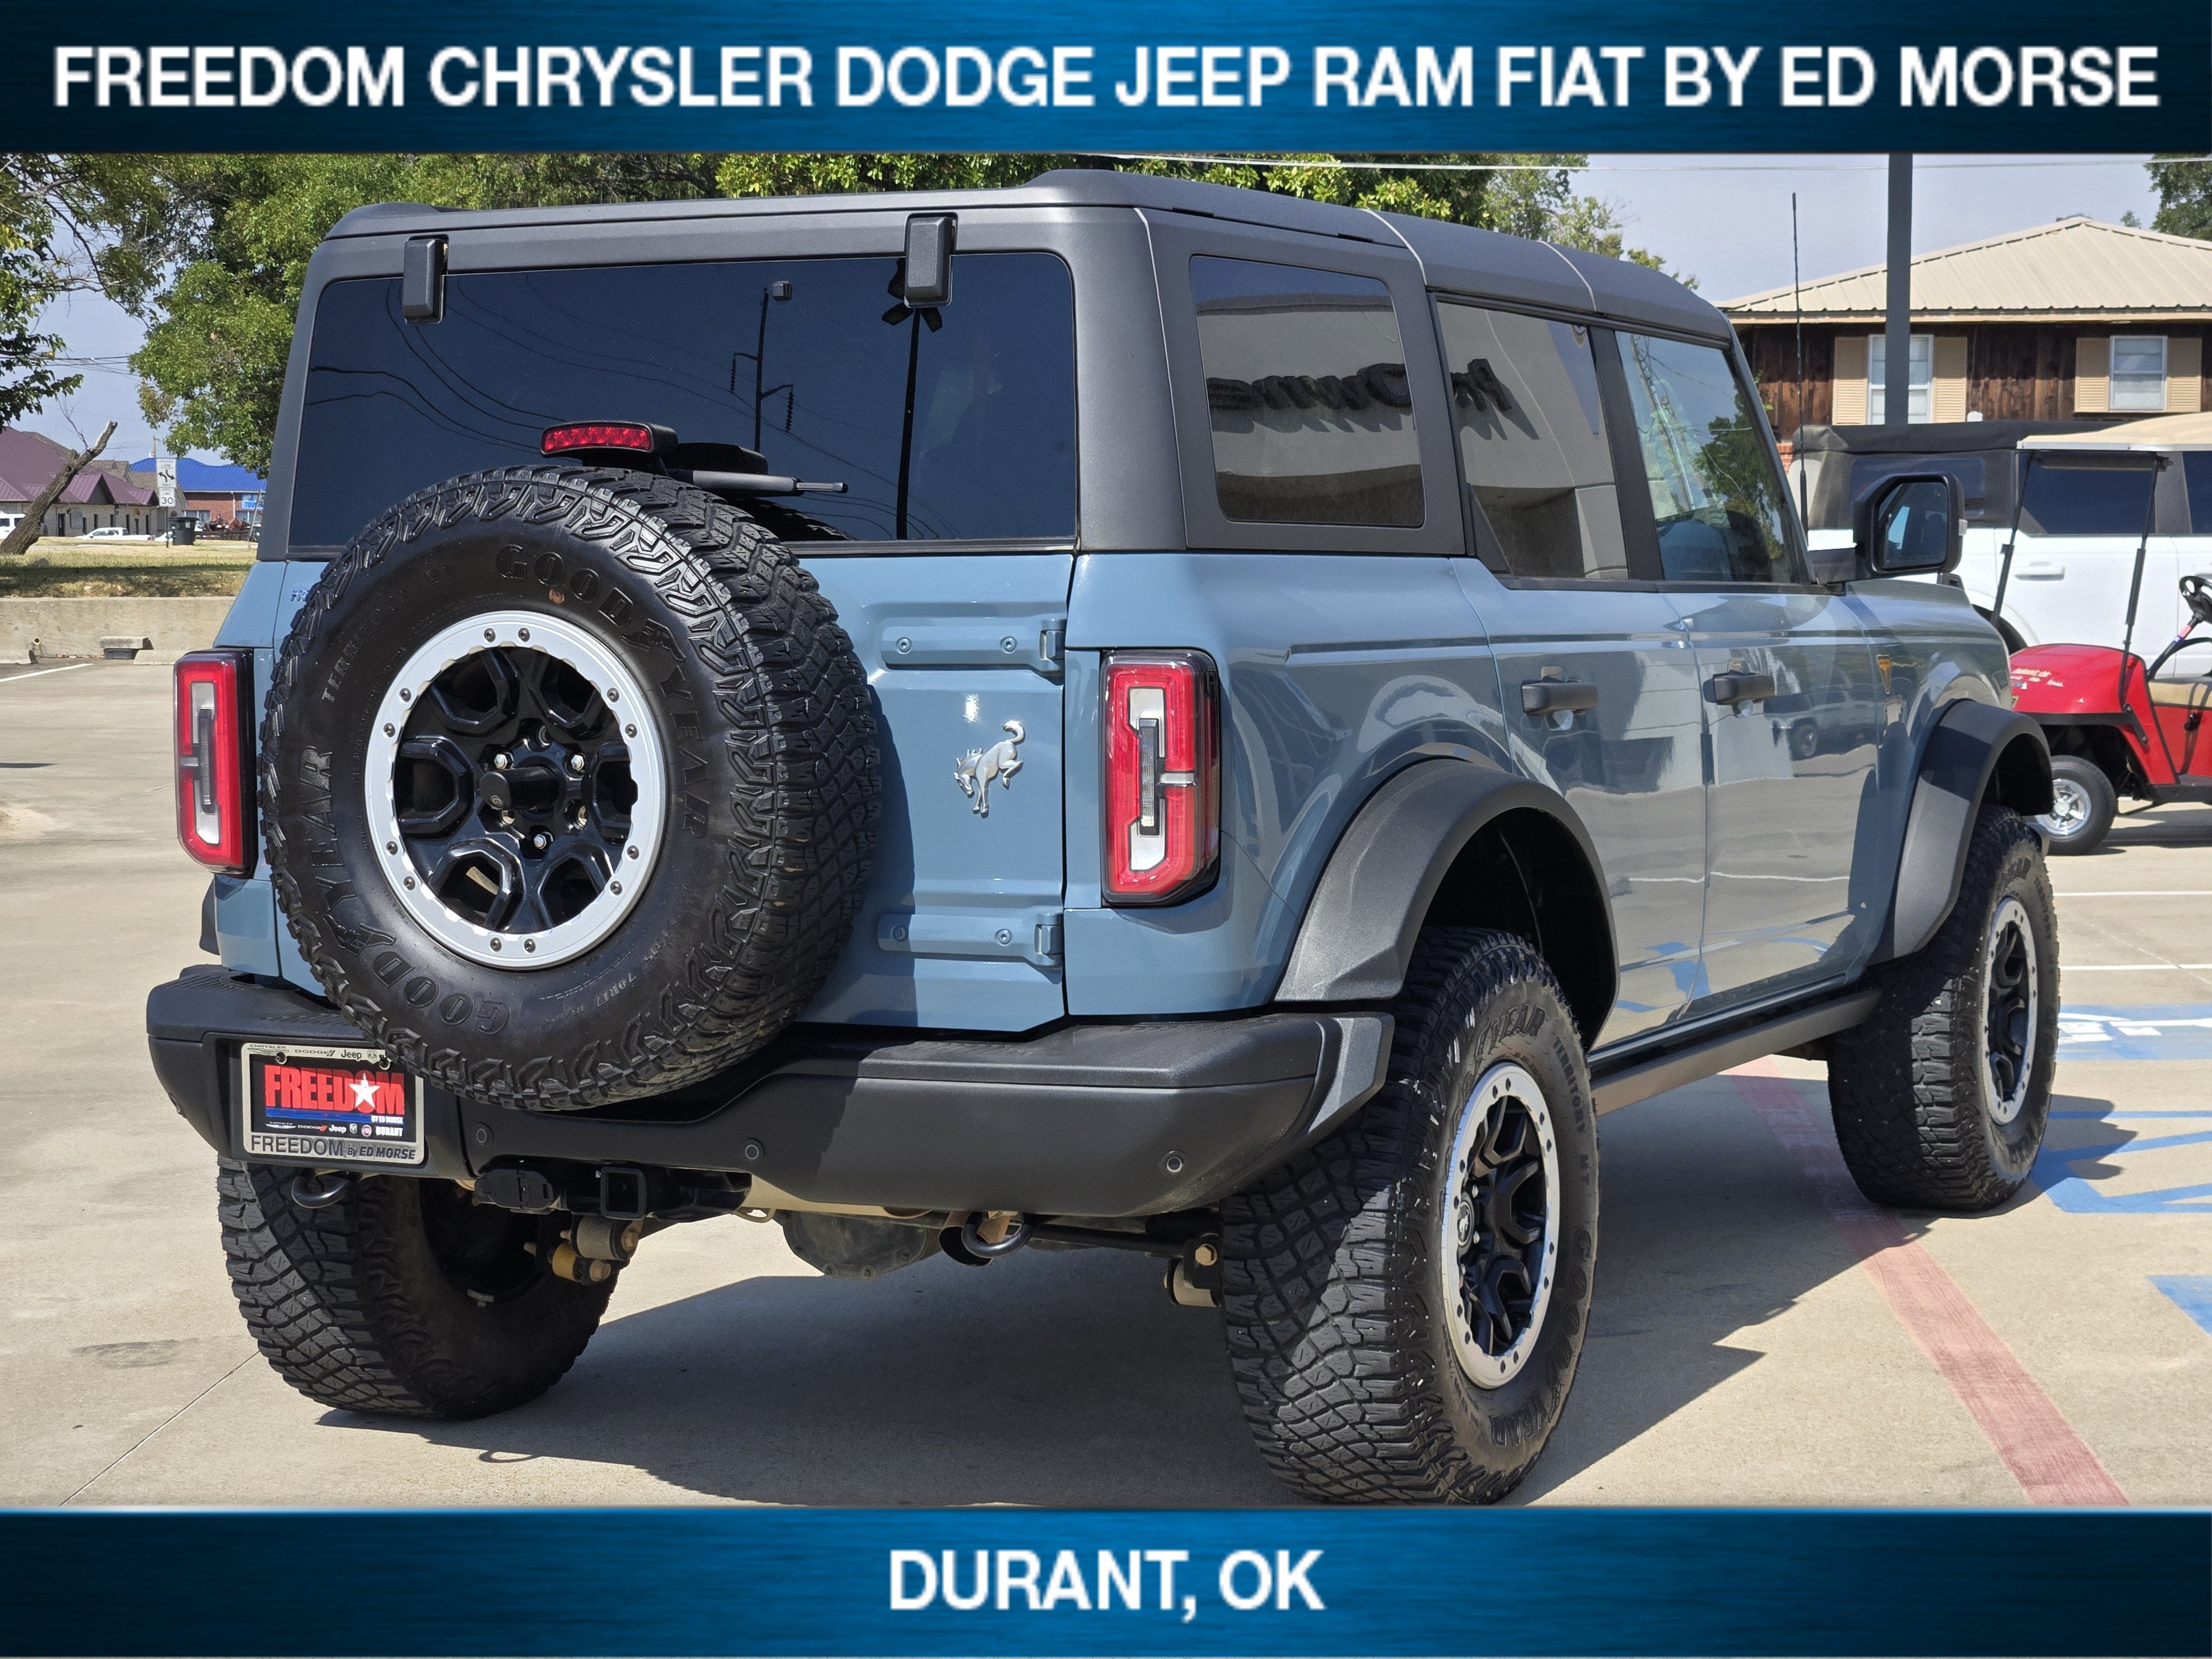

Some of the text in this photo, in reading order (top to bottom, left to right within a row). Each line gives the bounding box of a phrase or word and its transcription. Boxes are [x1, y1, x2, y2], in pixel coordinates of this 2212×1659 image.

[300, 745, 510, 1035] GOODYEAR
[341, 1050, 362, 1060] Jeep
[328, 1124, 347, 1134] Jeep
[251, 1135, 416, 1160] FREEDOM By ED MORSE
